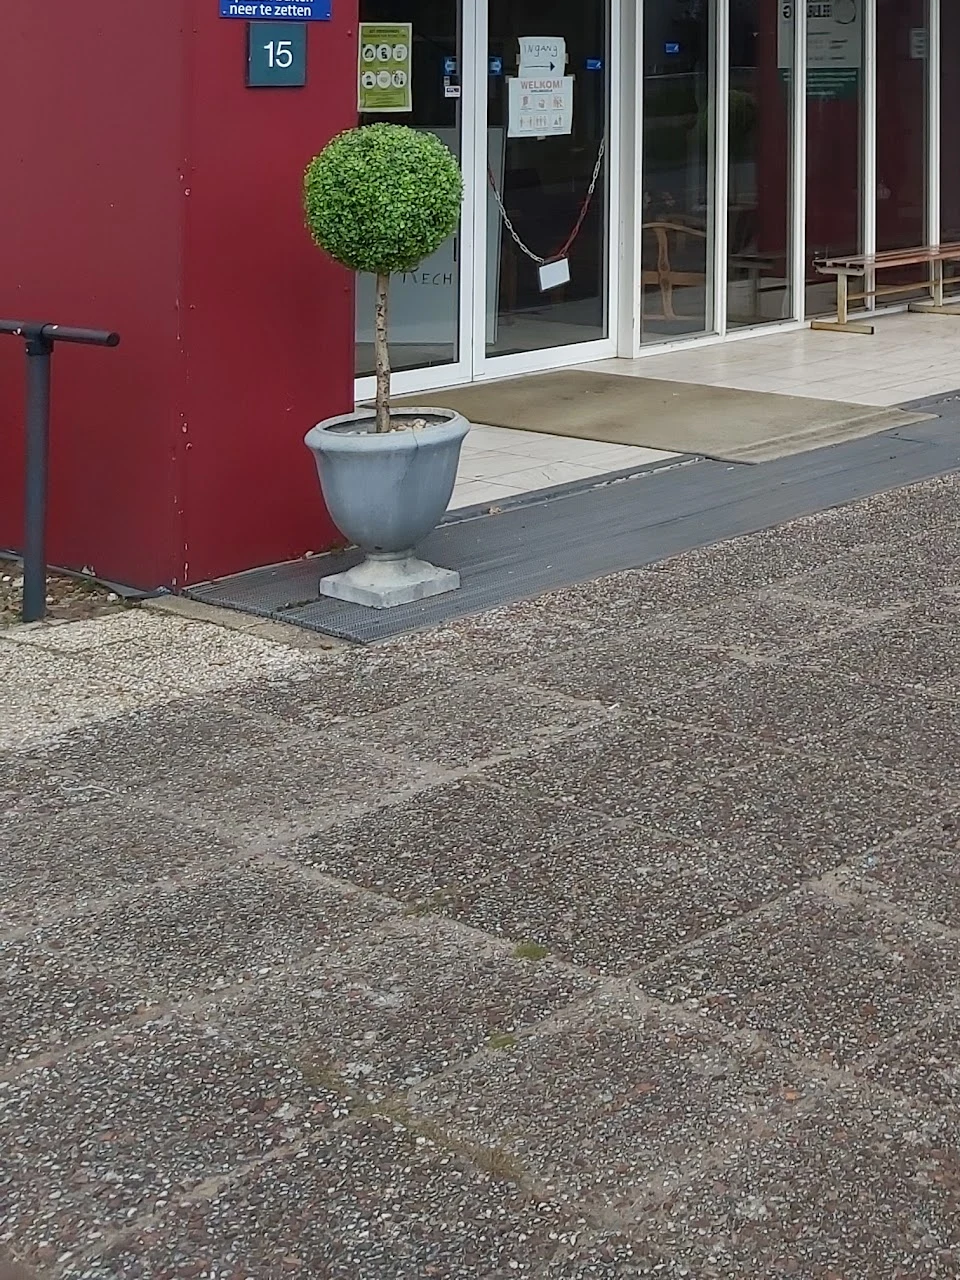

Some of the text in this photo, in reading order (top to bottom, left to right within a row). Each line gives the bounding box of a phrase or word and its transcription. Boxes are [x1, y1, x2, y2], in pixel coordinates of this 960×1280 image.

[229, 5, 312, 17] neer te zetten
[263, 41, 293, 68] 15
[521, 80, 563, 89] WELKOM!
